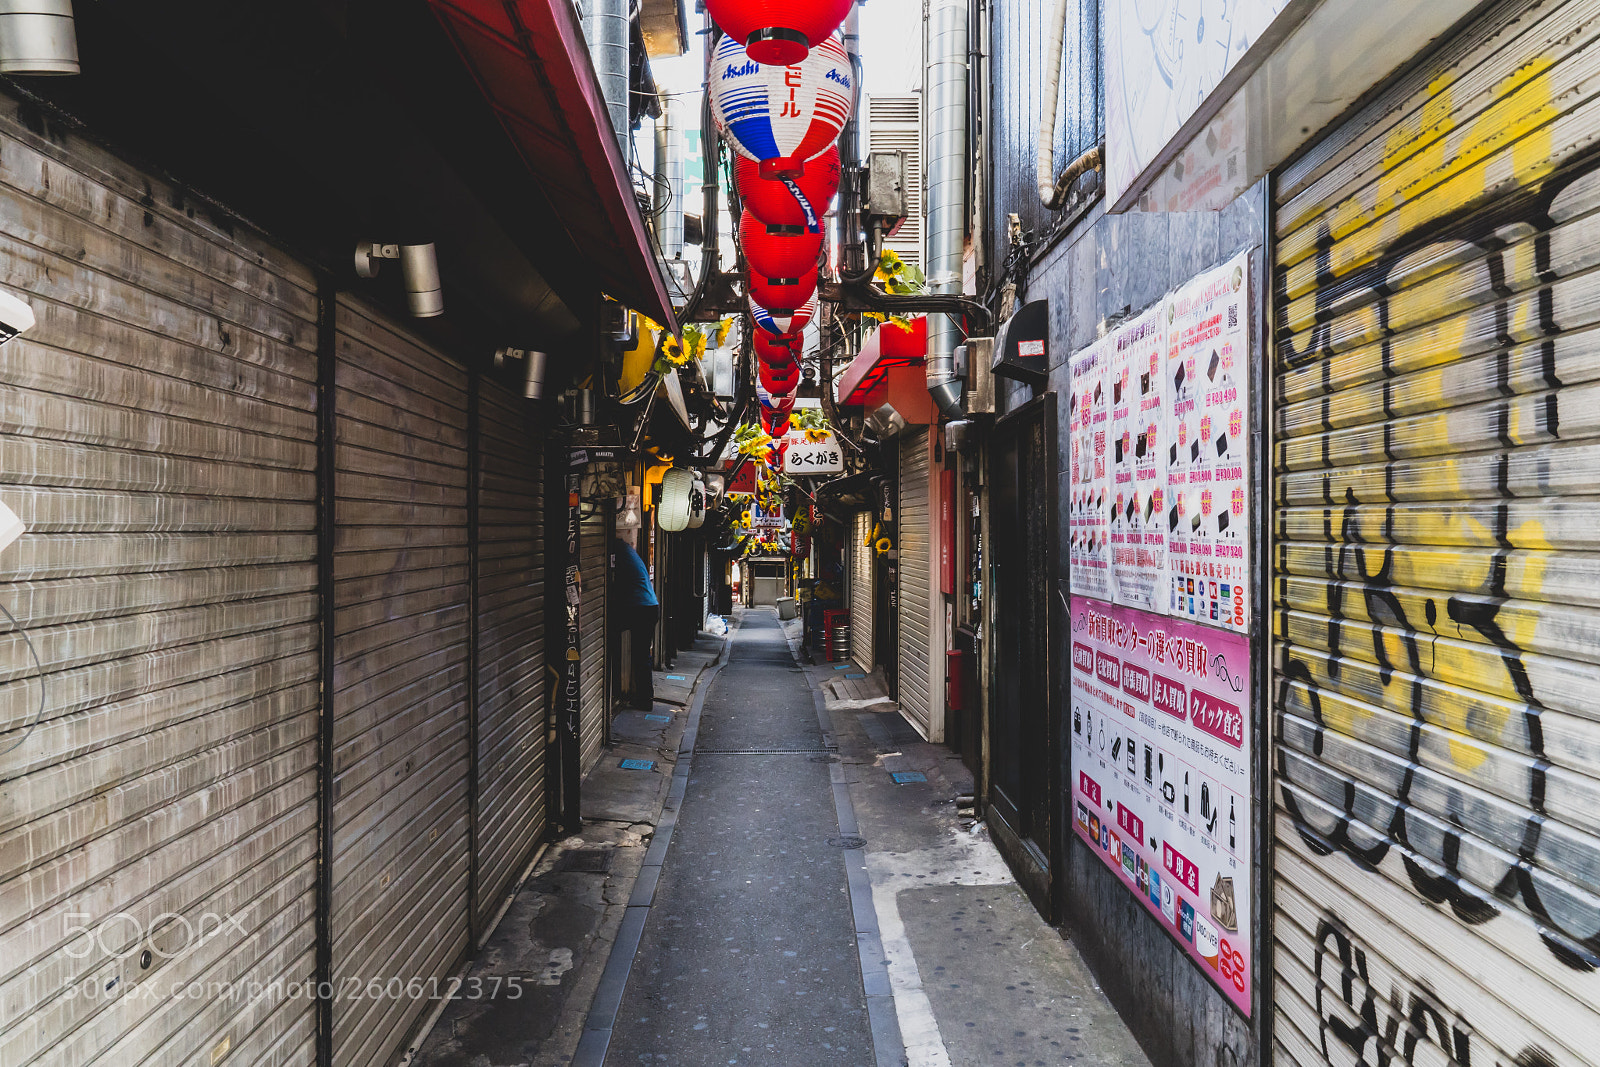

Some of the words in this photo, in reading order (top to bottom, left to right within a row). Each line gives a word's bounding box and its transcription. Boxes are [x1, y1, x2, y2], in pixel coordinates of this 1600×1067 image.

[722, 60, 760, 80] Asahi
[825, 68, 851, 90] Asahi
[791, 450, 839, 466] らくがき
[1088, 610, 1208, 680] 新宿買取センターの選べる買取
[1154, 680, 1186, 713] 法人買取
[1192, 697, 1242, 741] クイック査定
[1136, 865, 1148, 886] JCB
[1196, 920, 1218, 947] DISCOVER
